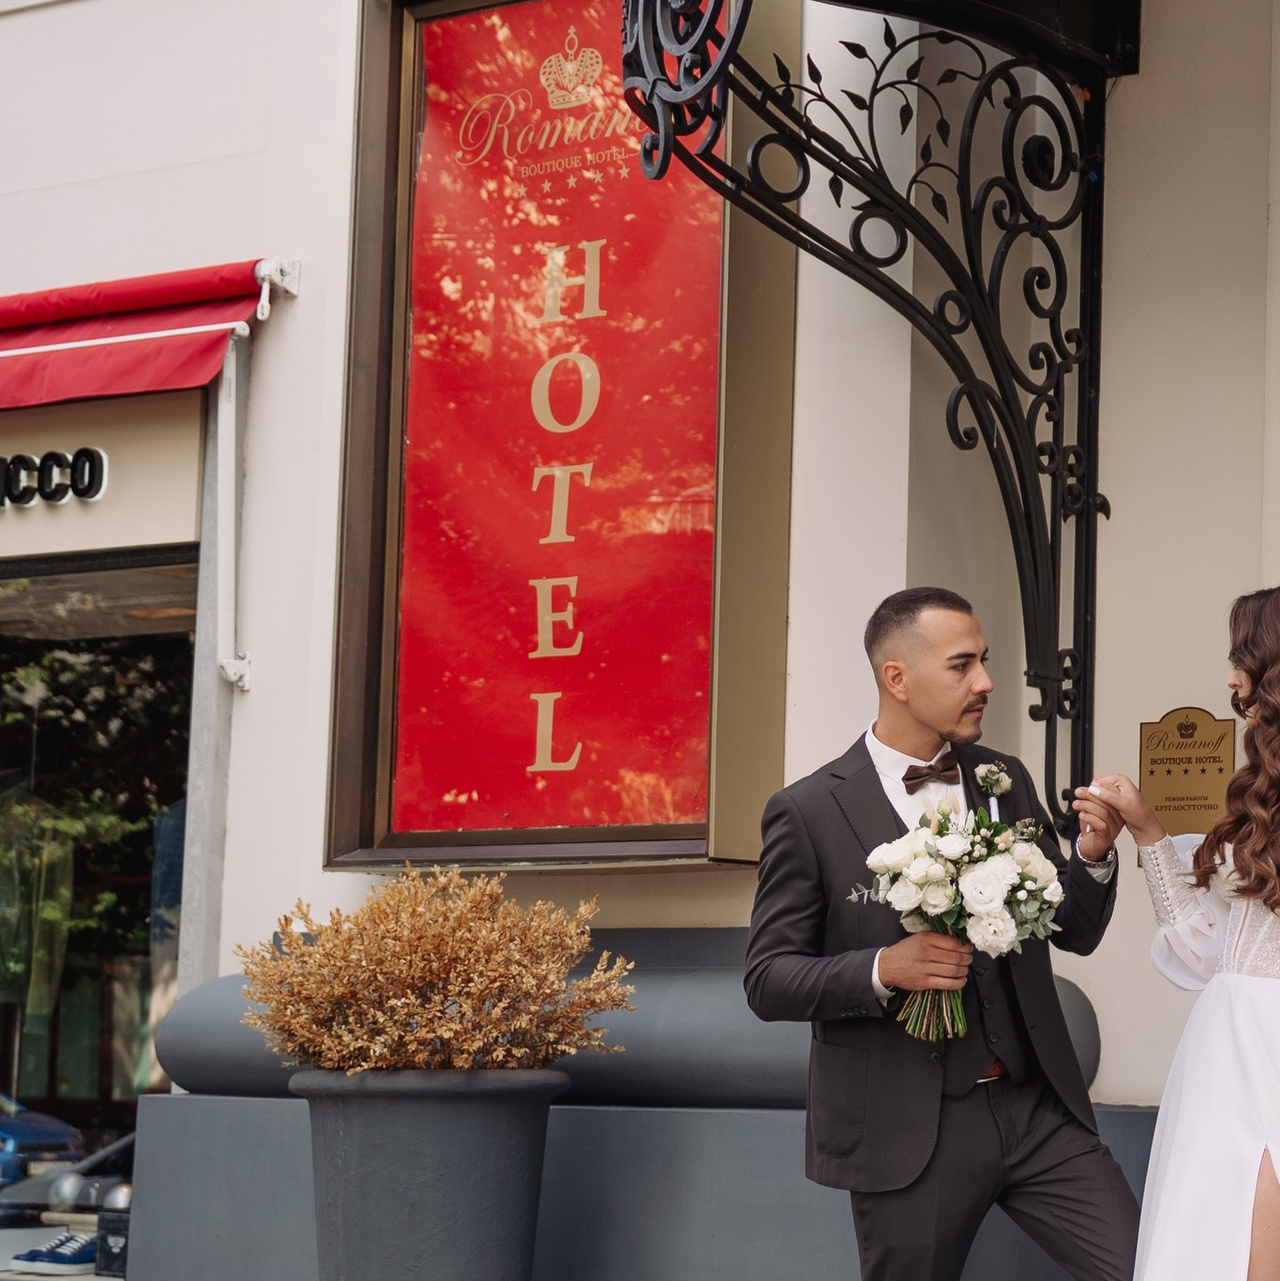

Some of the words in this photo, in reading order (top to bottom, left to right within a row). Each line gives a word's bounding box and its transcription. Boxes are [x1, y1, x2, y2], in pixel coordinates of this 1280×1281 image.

[520, 155, 583, 178] BOUTIQUE
[587, 147, 630, 165] HOTEL
[0, 446, 107, 507] CCO
[526, 238, 608, 774] HOTEL
[1146, 730, 1229, 754] Romanoff
[1150, 756, 1193, 766] BOUTIQUE
[1195, 755, 1223, 764] HOTEL
[1154, 803, 1219, 812] КРУГЛОСУТОЧНО
